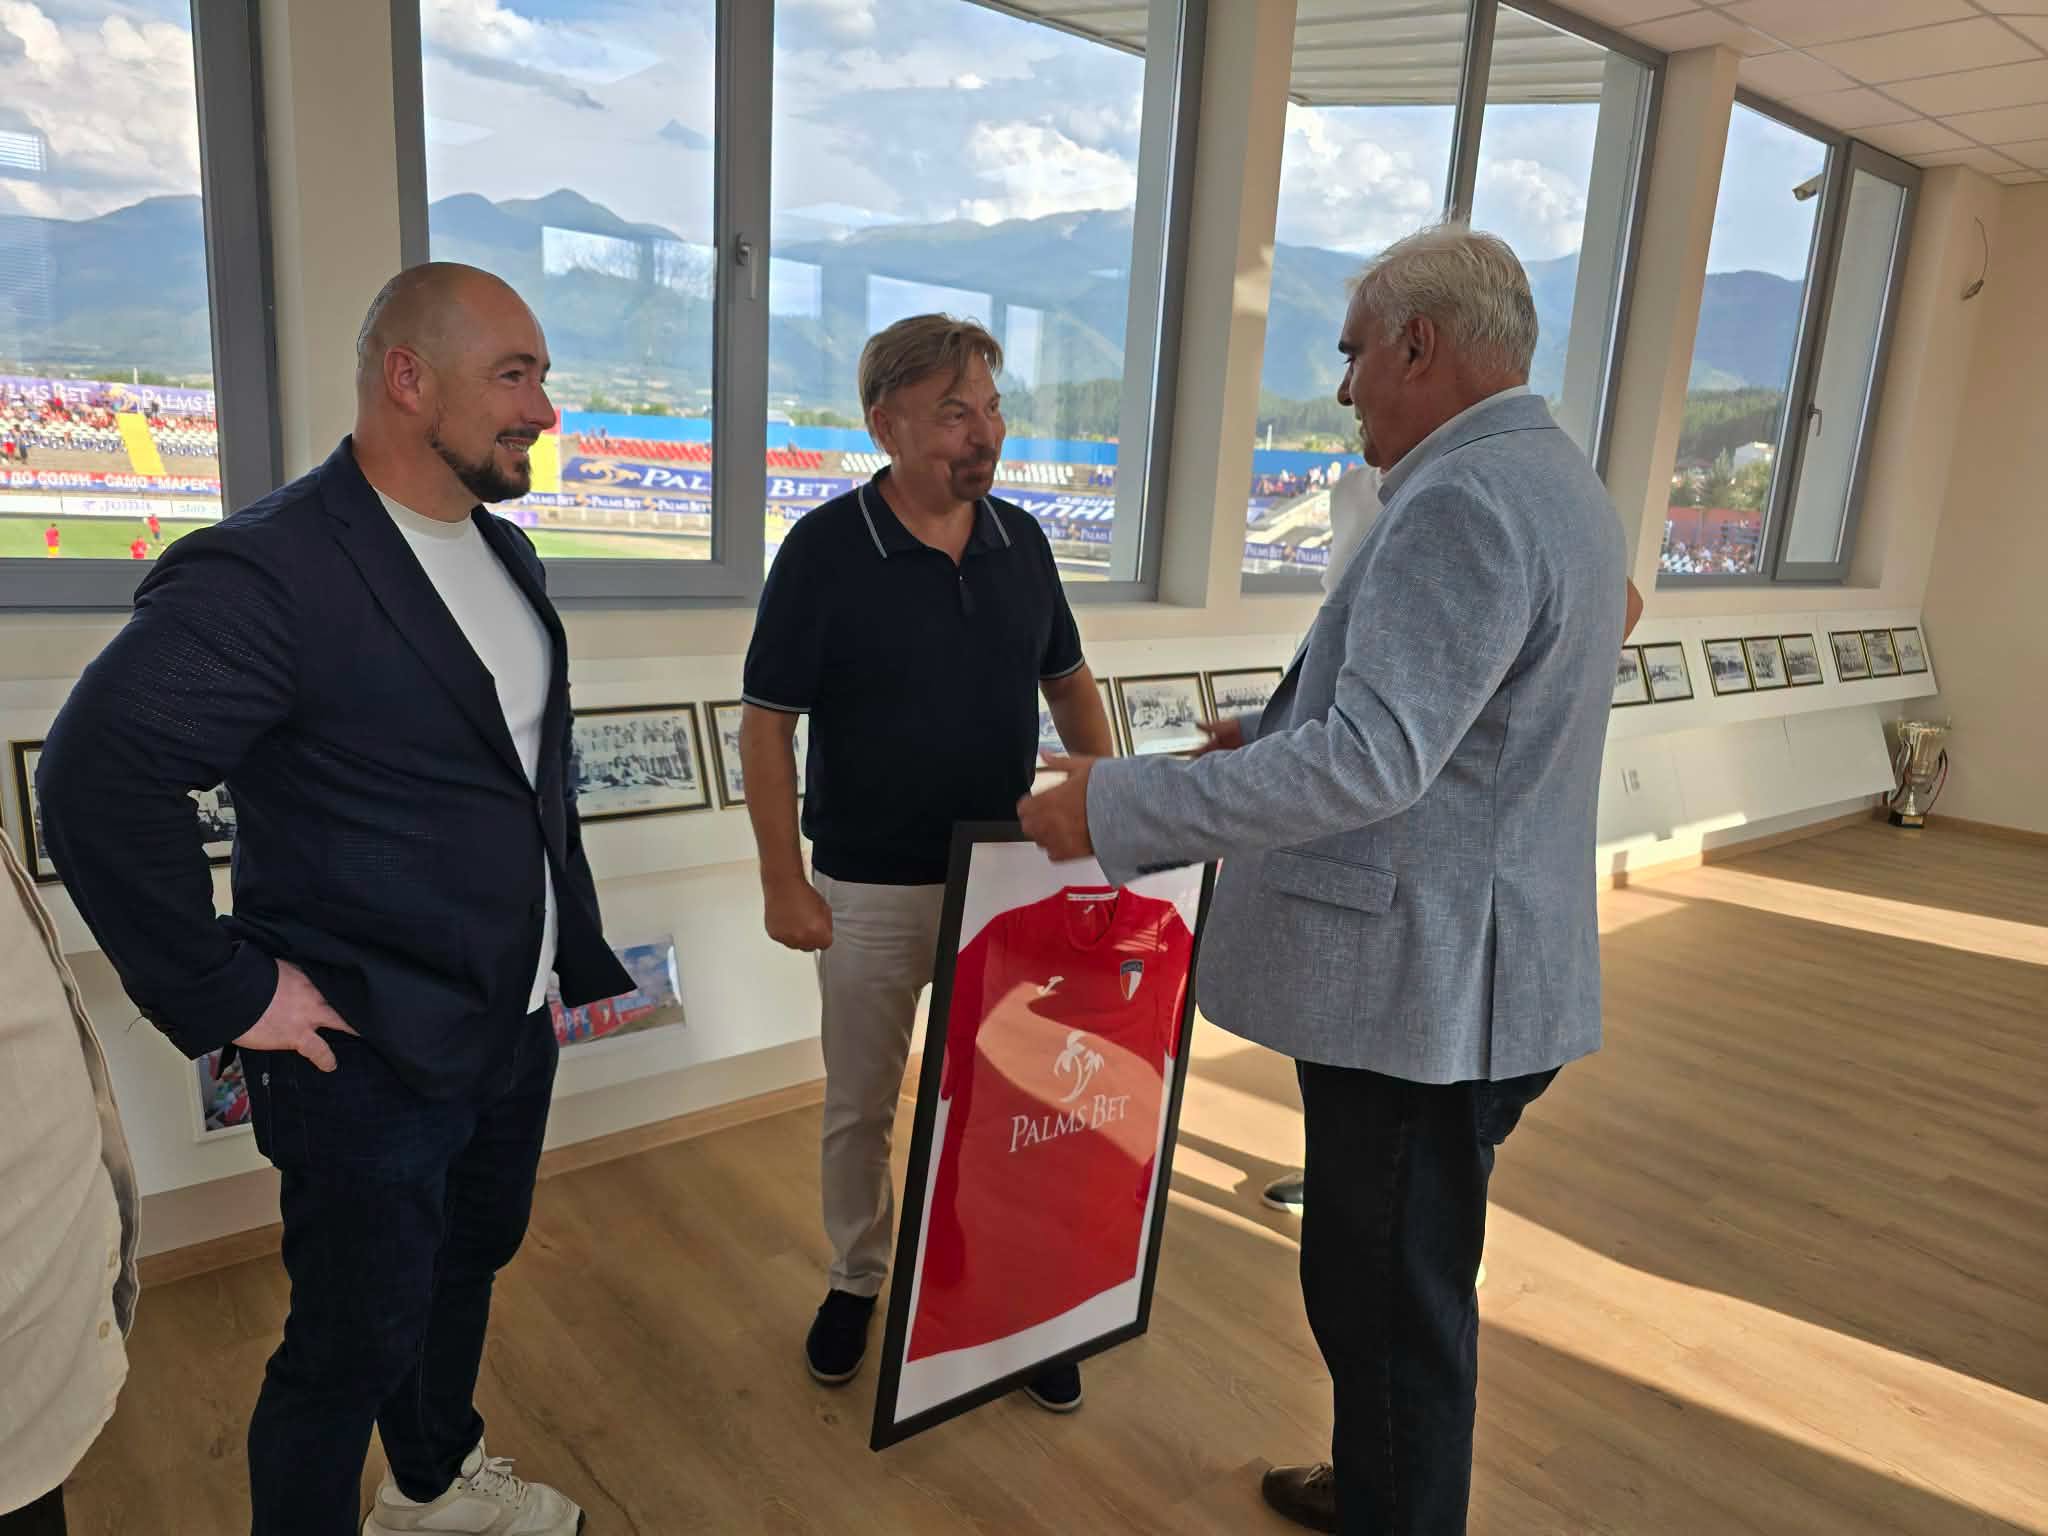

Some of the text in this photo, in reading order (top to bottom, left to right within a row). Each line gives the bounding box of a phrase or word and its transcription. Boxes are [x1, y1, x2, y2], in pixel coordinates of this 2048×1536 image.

[0, 383, 49, 401] LMS
[640, 468, 711, 490] PAL
[770, 479, 838, 497] BET
[1009, 1094, 1129, 1152] PALMS BET
